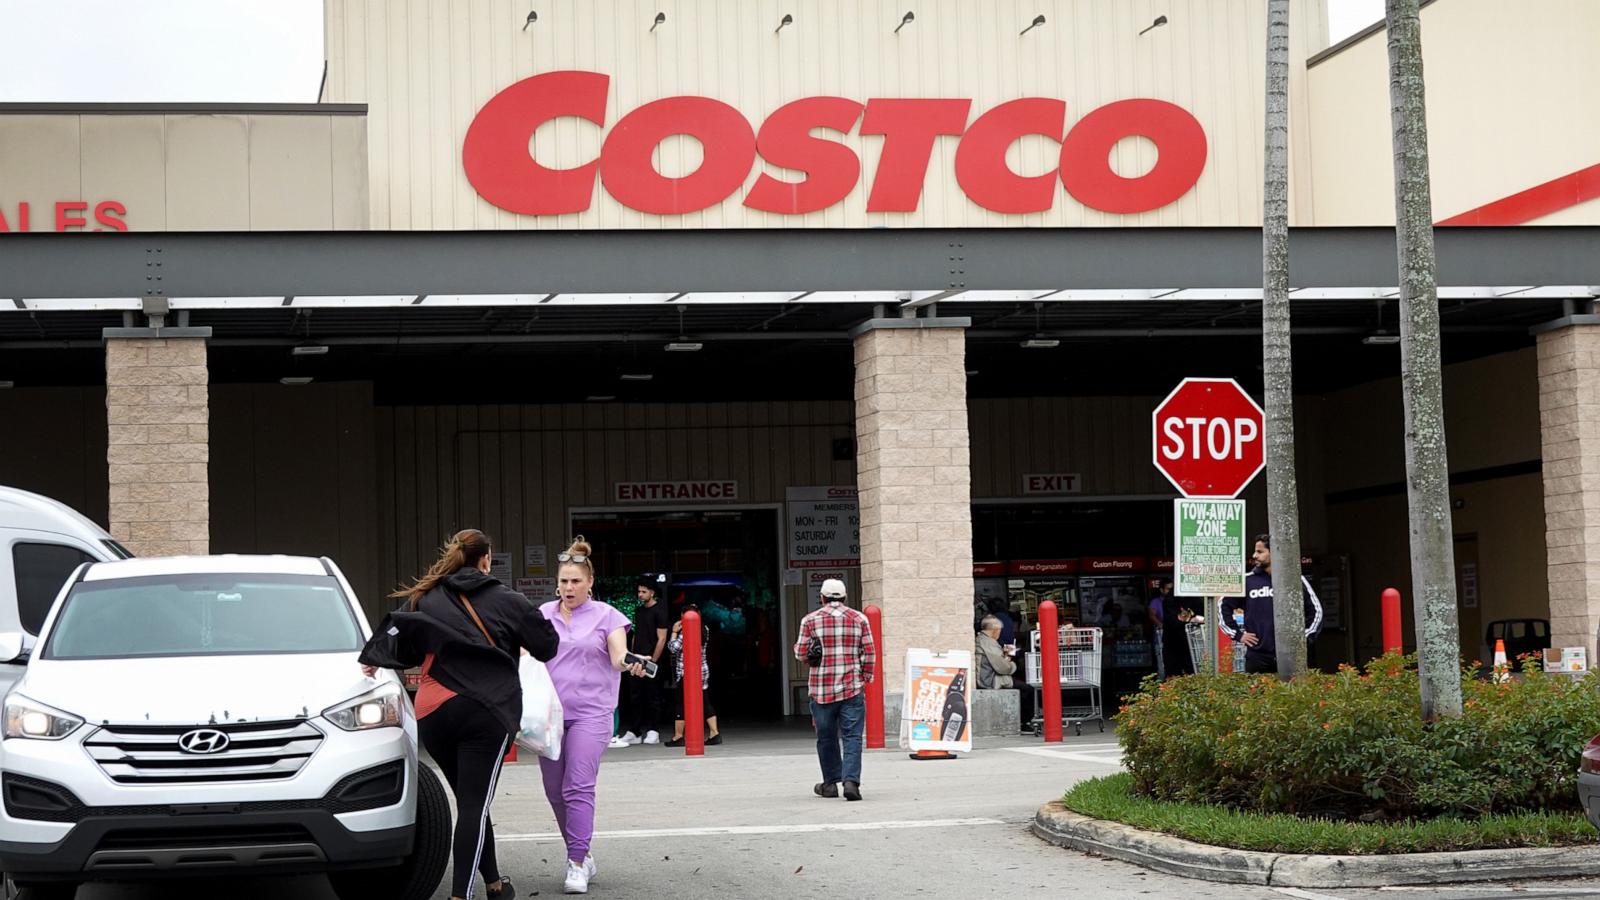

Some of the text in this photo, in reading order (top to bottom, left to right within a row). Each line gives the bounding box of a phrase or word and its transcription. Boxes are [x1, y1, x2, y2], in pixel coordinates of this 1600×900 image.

[463, 70, 1208, 216] COSTCO
[0, 201, 128, 232] LES
[1162, 416, 1258, 461] STOP
[618, 482, 735, 499] ENTRANCE
[1029, 476, 1075, 490] EXIT
[1181, 503, 1241, 521] TOW-AWAY
[795, 516, 815, 526] MON
[825, 516, 838, 526] FRI
[1196, 520, 1227, 537] ZONE
[795, 530, 836, 541] SATURDAY
[796, 545, 828, 555] SUNDAY
[1112, 560, 1133, 569] Flooring
